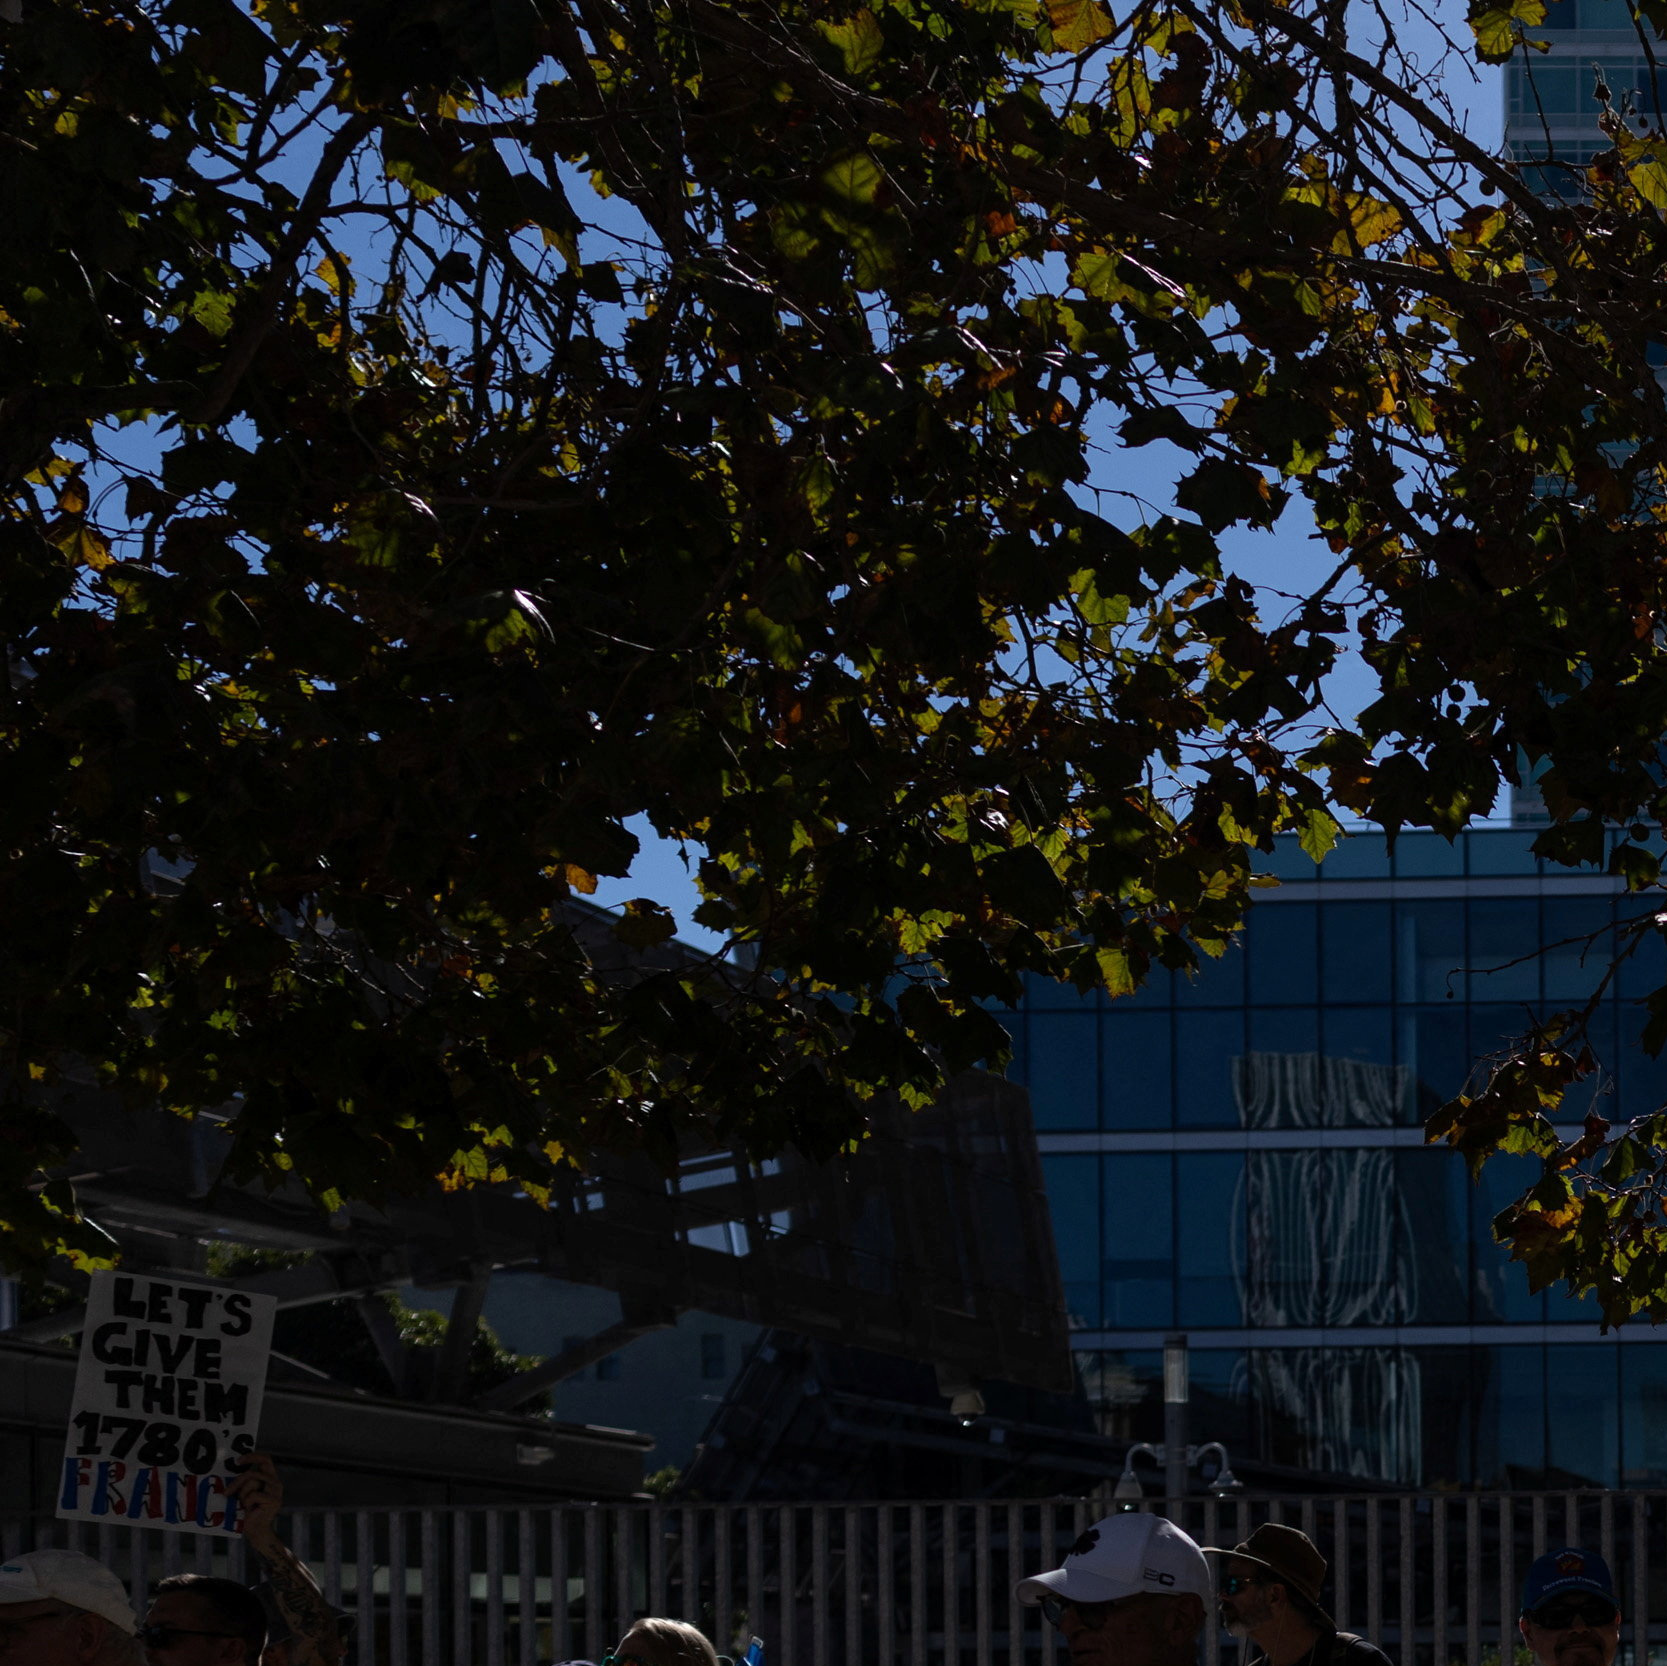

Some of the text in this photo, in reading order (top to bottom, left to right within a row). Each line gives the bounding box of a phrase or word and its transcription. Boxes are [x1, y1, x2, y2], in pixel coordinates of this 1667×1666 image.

[113, 1277, 252, 1337] LET'S
[92, 1322, 221, 1379] GIVE
[104, 1370, 249, 1426] THEM
